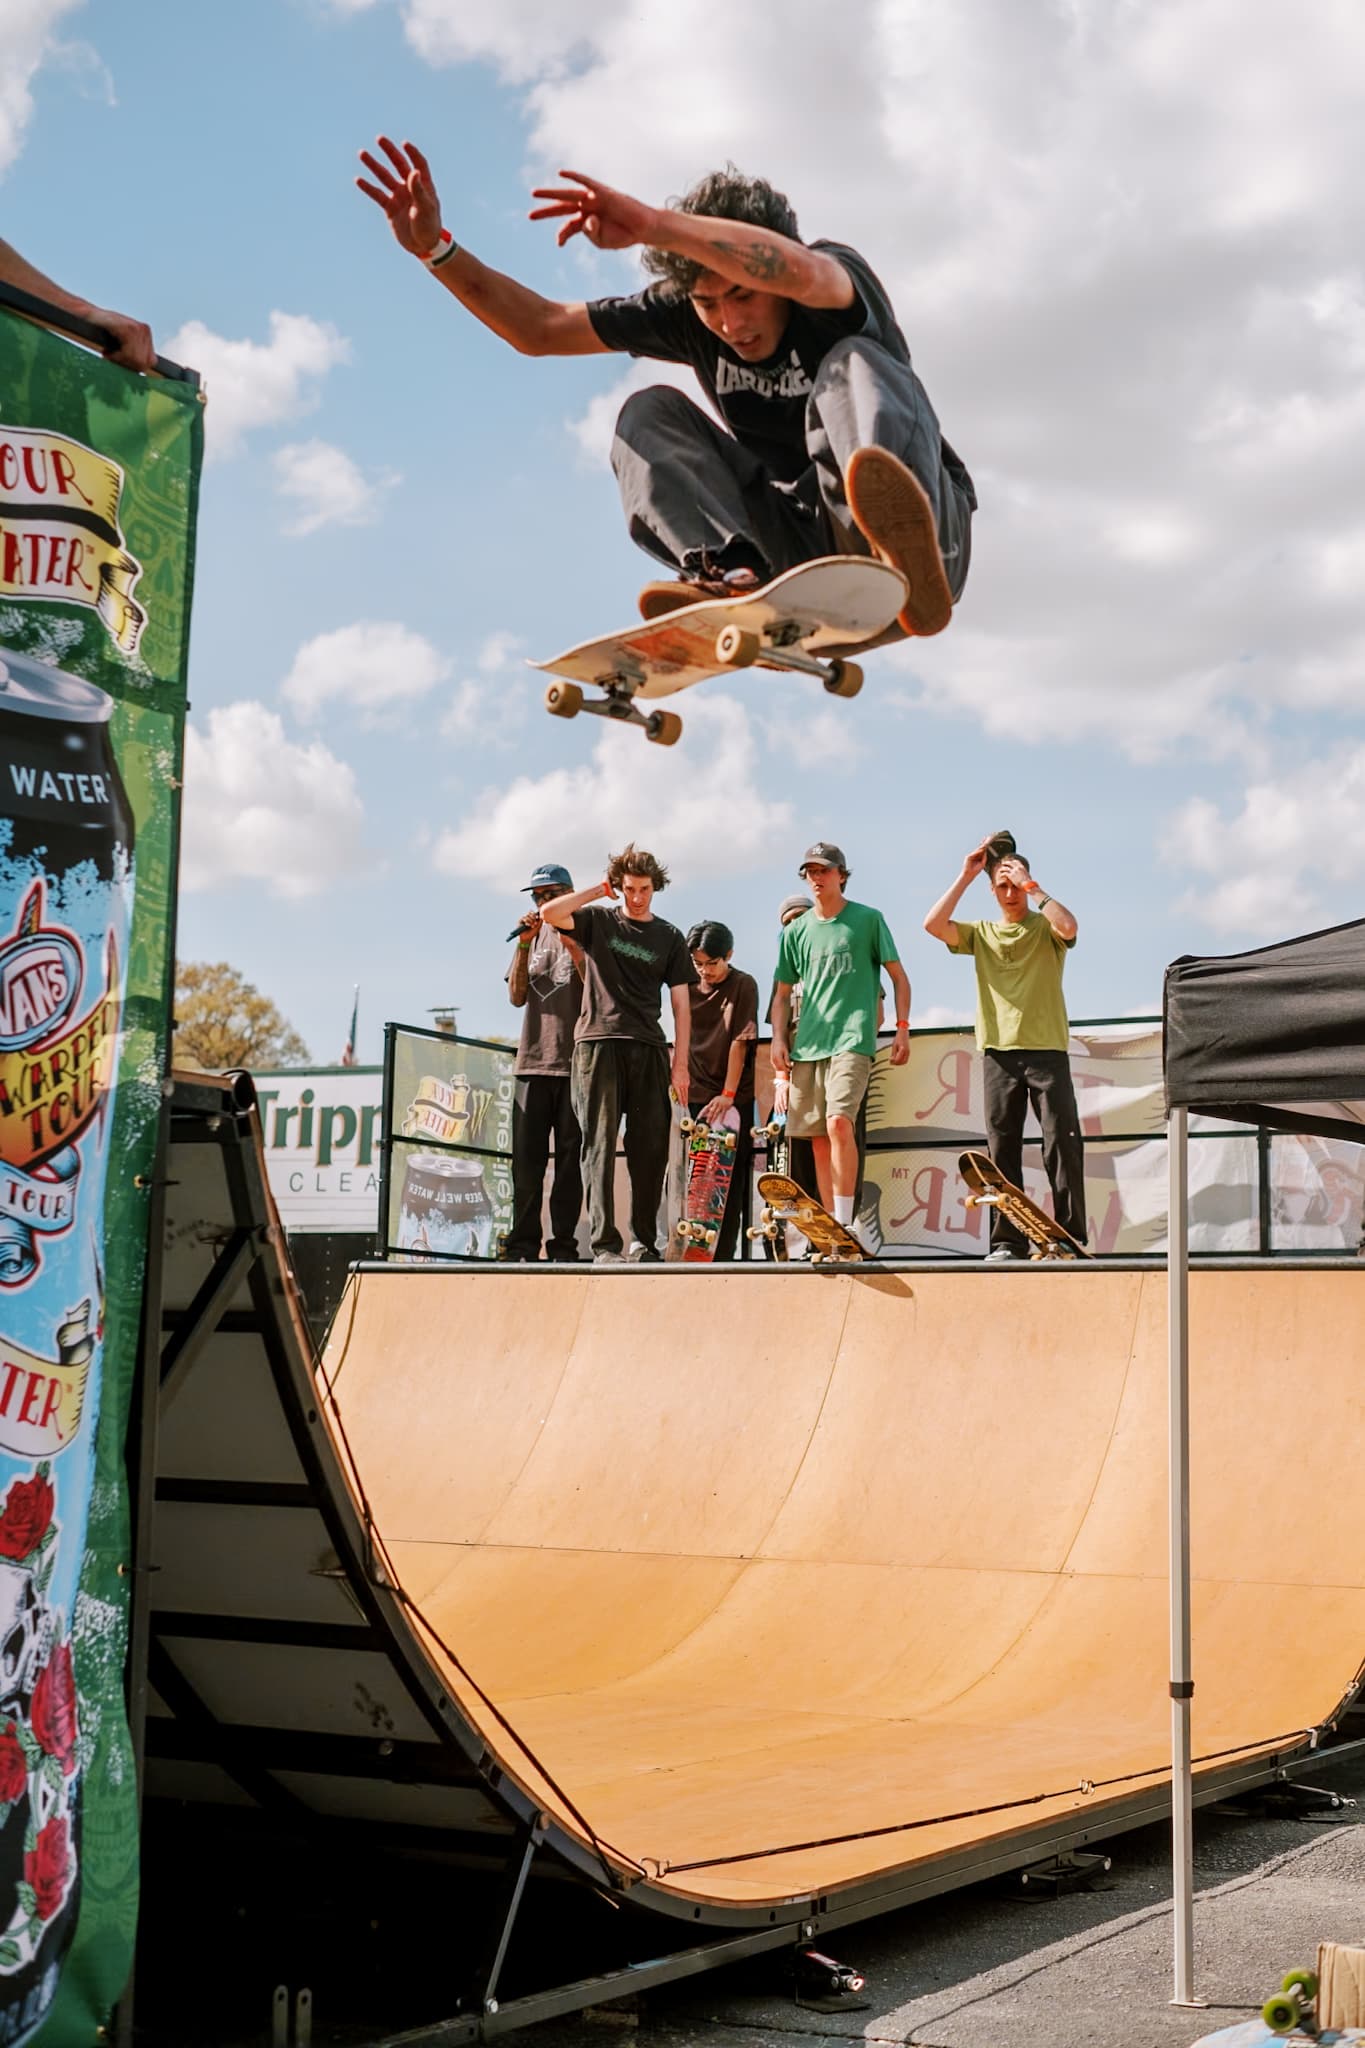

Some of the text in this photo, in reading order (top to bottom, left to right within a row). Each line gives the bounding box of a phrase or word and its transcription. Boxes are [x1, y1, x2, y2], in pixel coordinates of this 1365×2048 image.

[0, 525, 94, 591] ATER
[9, 764, 109, 803] WATER
[22, 1056, 104, 1152] TOUR
[6, 1178, 67, 1219] TOUR
[289, 1171, 378, 1192] CLEA
[0, 1361, 63, 1440] TER
